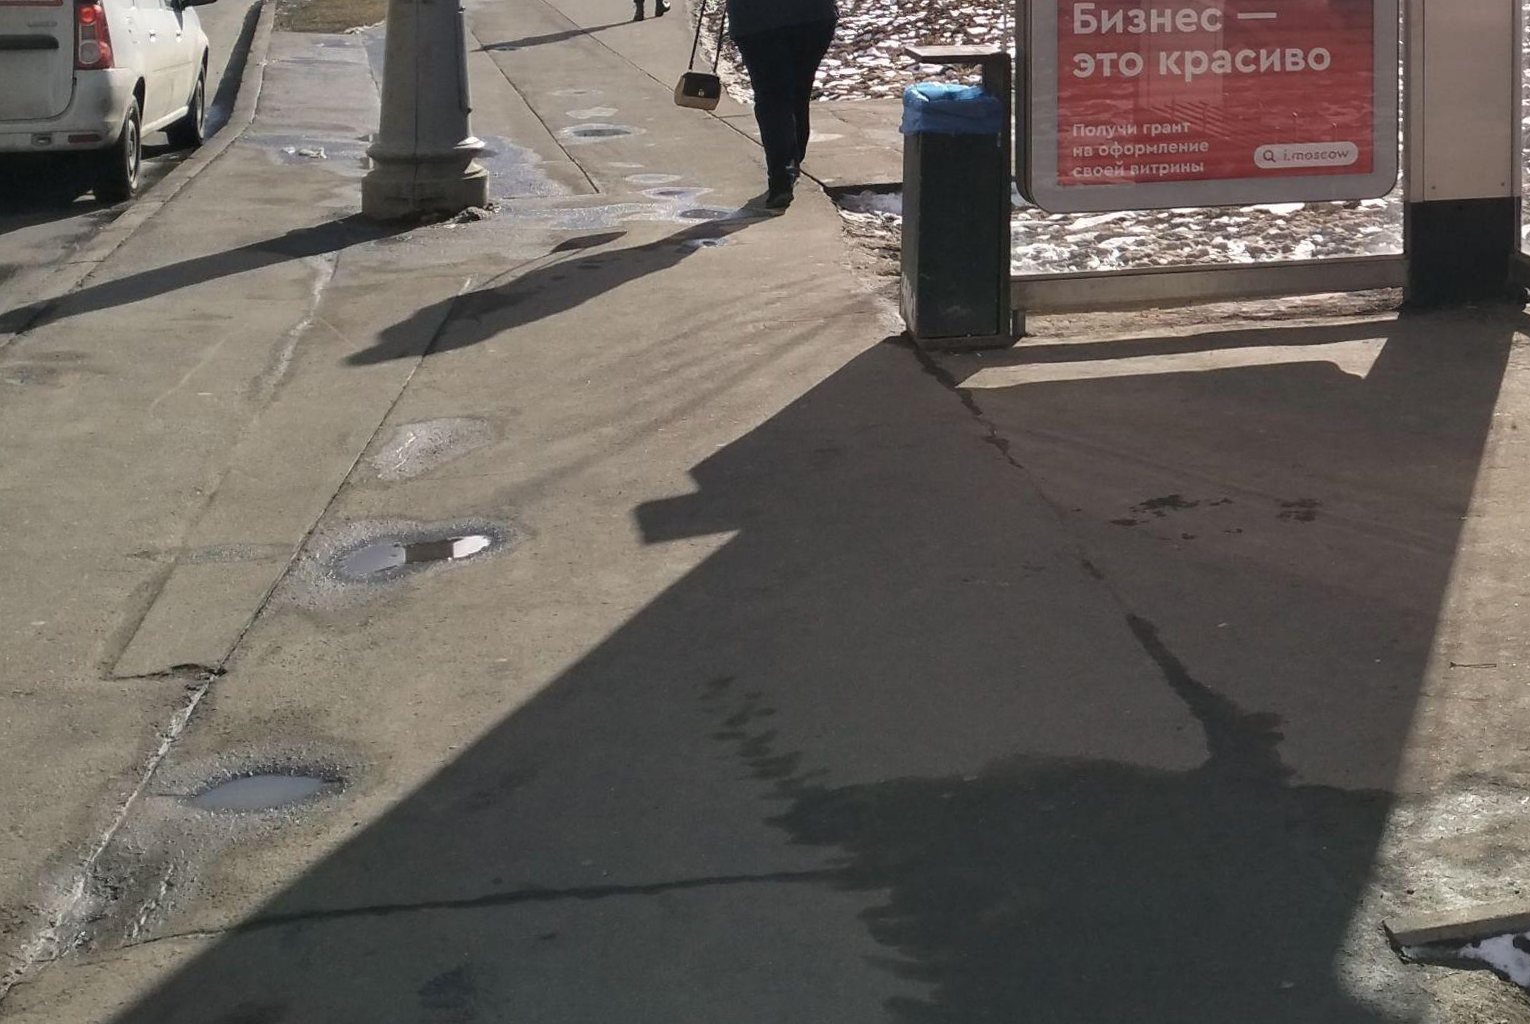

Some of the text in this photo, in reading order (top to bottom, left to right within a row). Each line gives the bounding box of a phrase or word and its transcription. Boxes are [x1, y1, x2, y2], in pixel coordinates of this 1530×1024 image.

[1072, 2, 1223, 34] Бизнес
[1072, 47, 1331, 82] это красиво
[1072, 120, 1191, 139] Получи грант
[1072, 140, 1209, 158] на оформление
[1282, 148, 1350, 163] i.moscow
[1071, 160, 1205, 177] своей витрины
